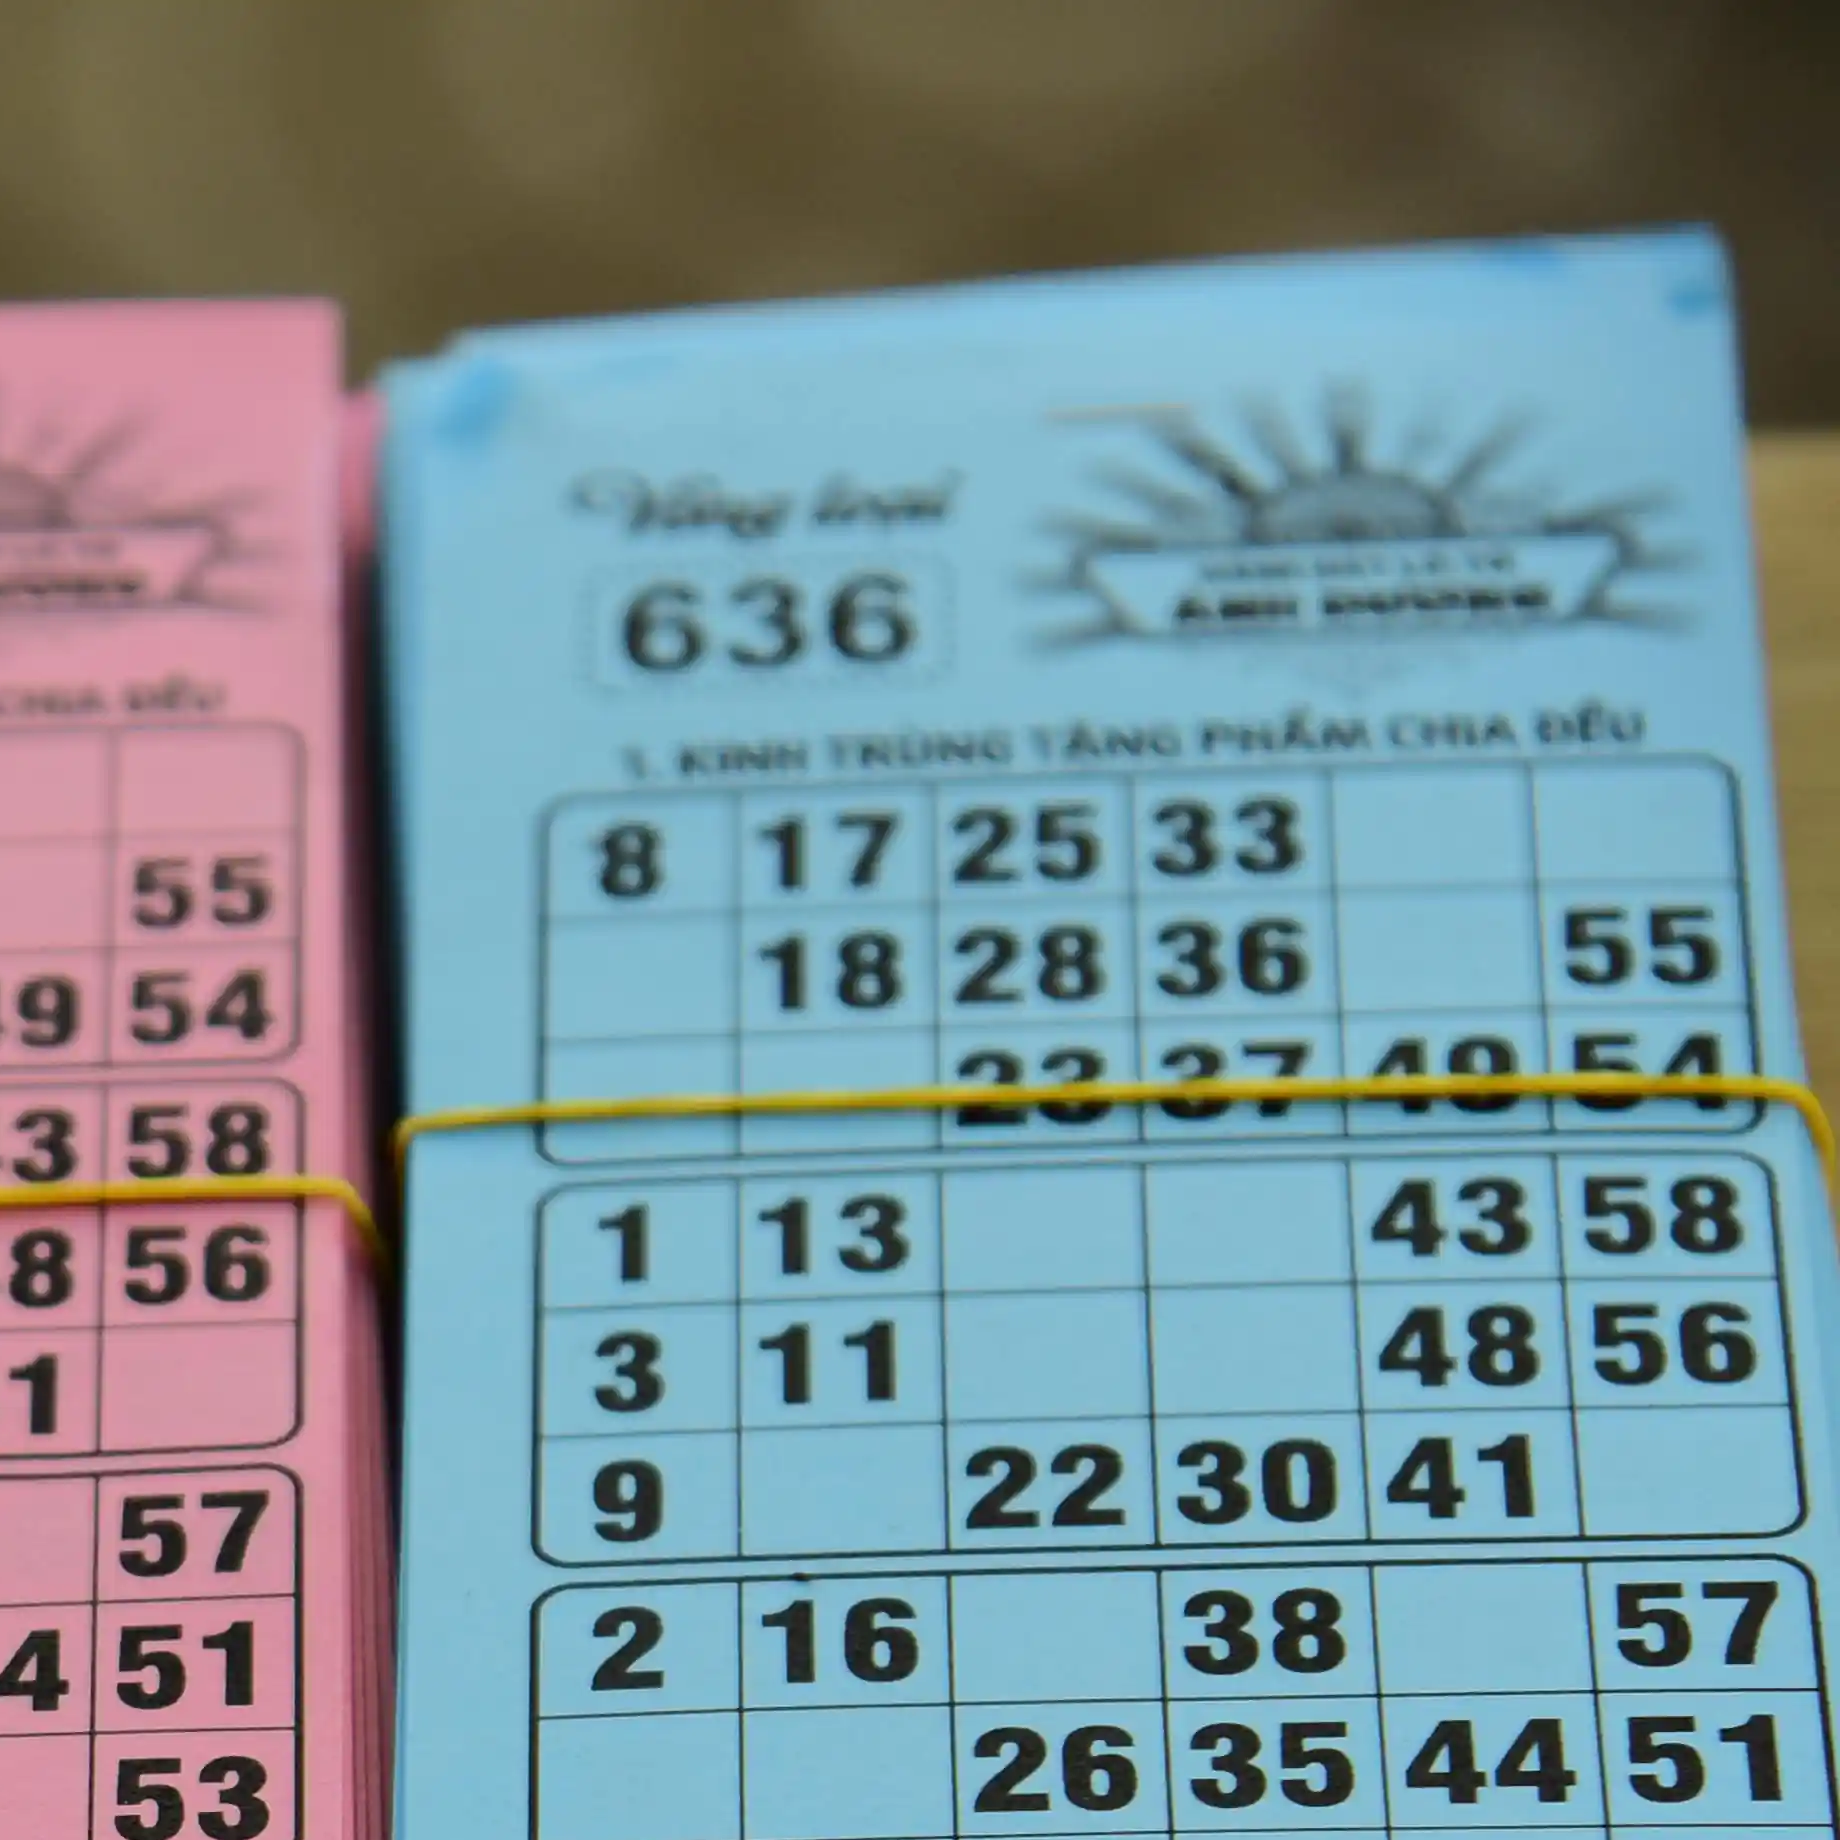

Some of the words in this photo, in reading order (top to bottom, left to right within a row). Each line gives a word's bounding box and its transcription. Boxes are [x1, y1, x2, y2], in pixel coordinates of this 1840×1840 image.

[619, 574, 915, 675] 636
[129, 968, 273, 1047] 54
[761, 931, 902, 1012] 18
[953, 925, 1104, 1006] 28
[1155, 917, 1307, 1000] 36
[1563, 907, 1720, 987] 55
[123, 1224, 271, 1307] 56
[597, 1204, 648, 1285] 1
[757, 1194, 910, 1277] 13
[1369, 1176, 1533, 1258] 43
[1582, 1174, 1744, 1257] 58
[117, 1489, 270, 1579] 57
[591, 1459, 664, 1544] 9
[964, 1442, 1126, 1531] 22
[1175, 1438, 1338, 1527] 30
[1385, 1433, 1535, 1520] 41
[972, 1724, 1139, 1814] 26
[1188, 1720, 1356, 1810] 35
[1404, 1717, 1578, 1805] 44
[1626, 1713, 1783, 1805] 51
